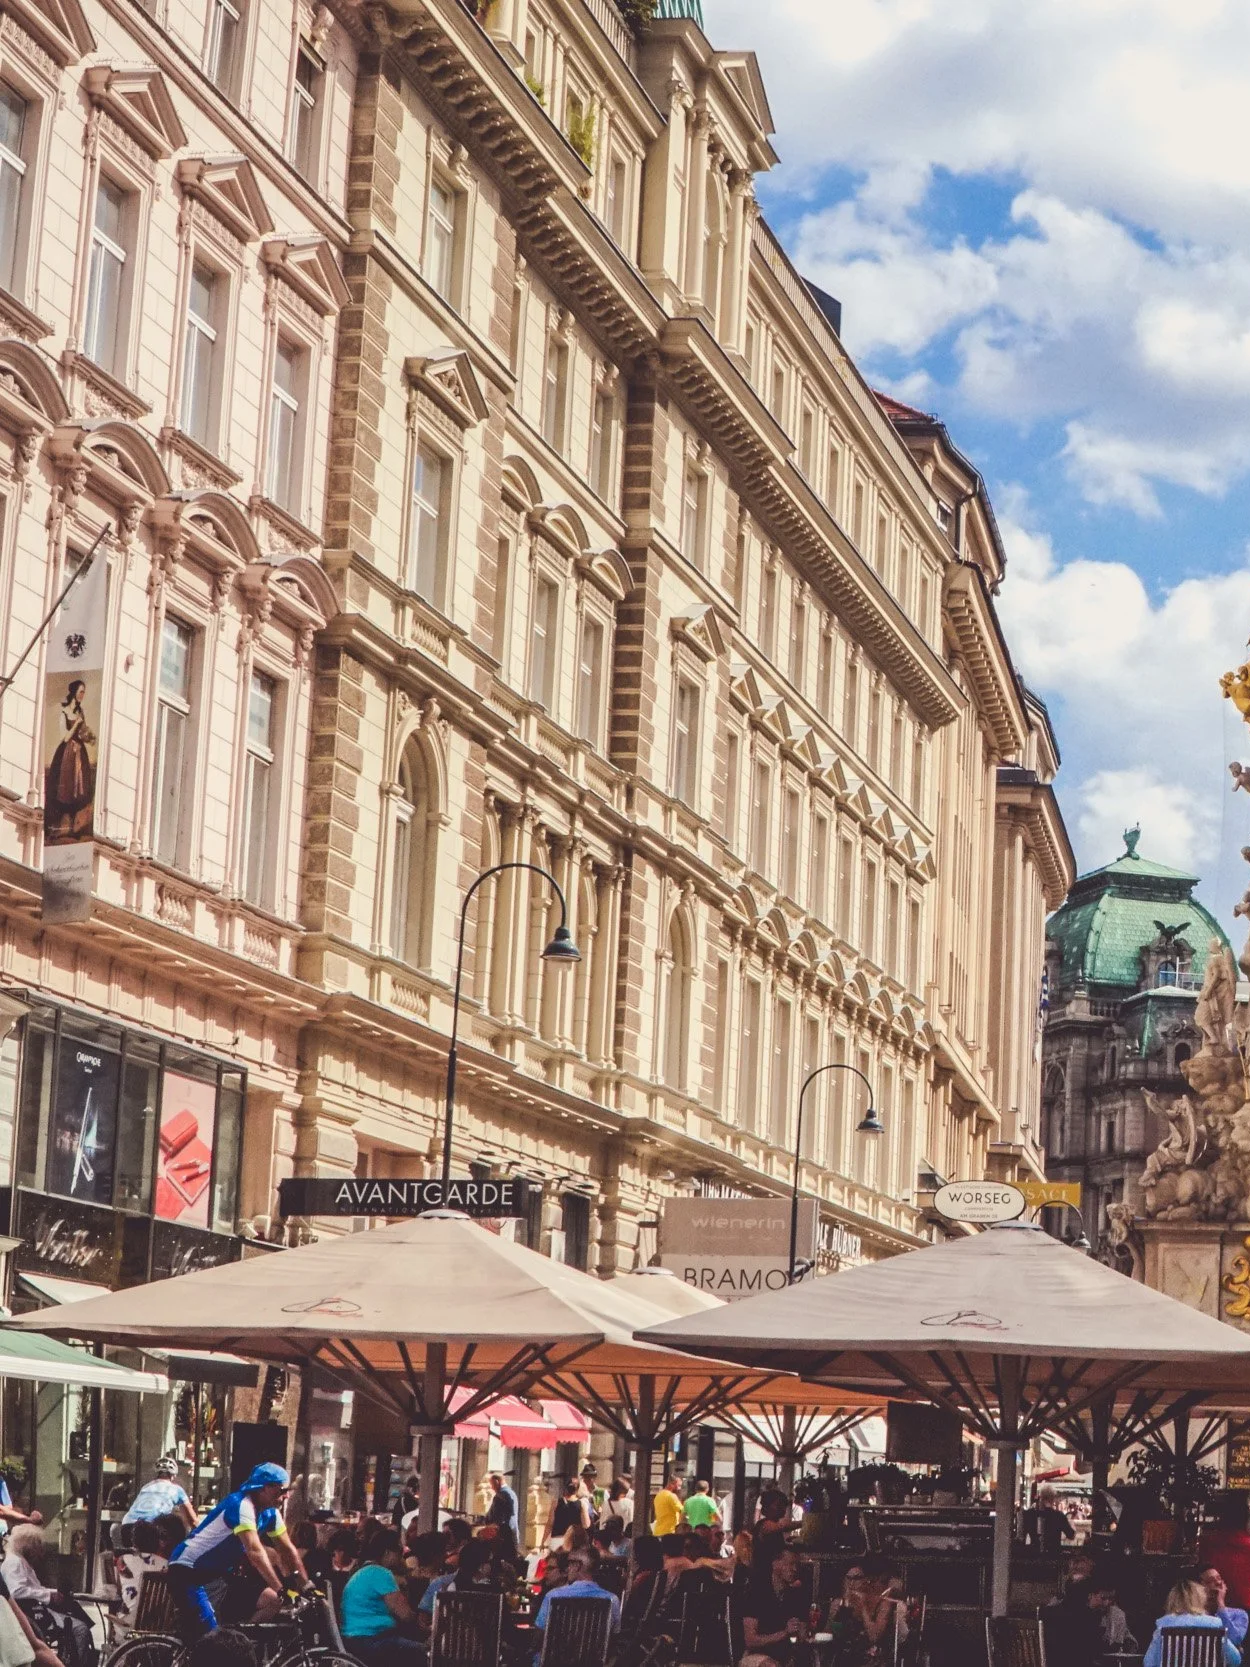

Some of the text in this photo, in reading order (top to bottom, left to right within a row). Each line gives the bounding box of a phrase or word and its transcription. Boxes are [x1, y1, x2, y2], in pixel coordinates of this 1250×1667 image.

[335, 1182, 514, 1206] AVANTGARDE
[948, 1192, 1011, 1205] WORSEG
[691, 1217, 785, 1230] wienerin
